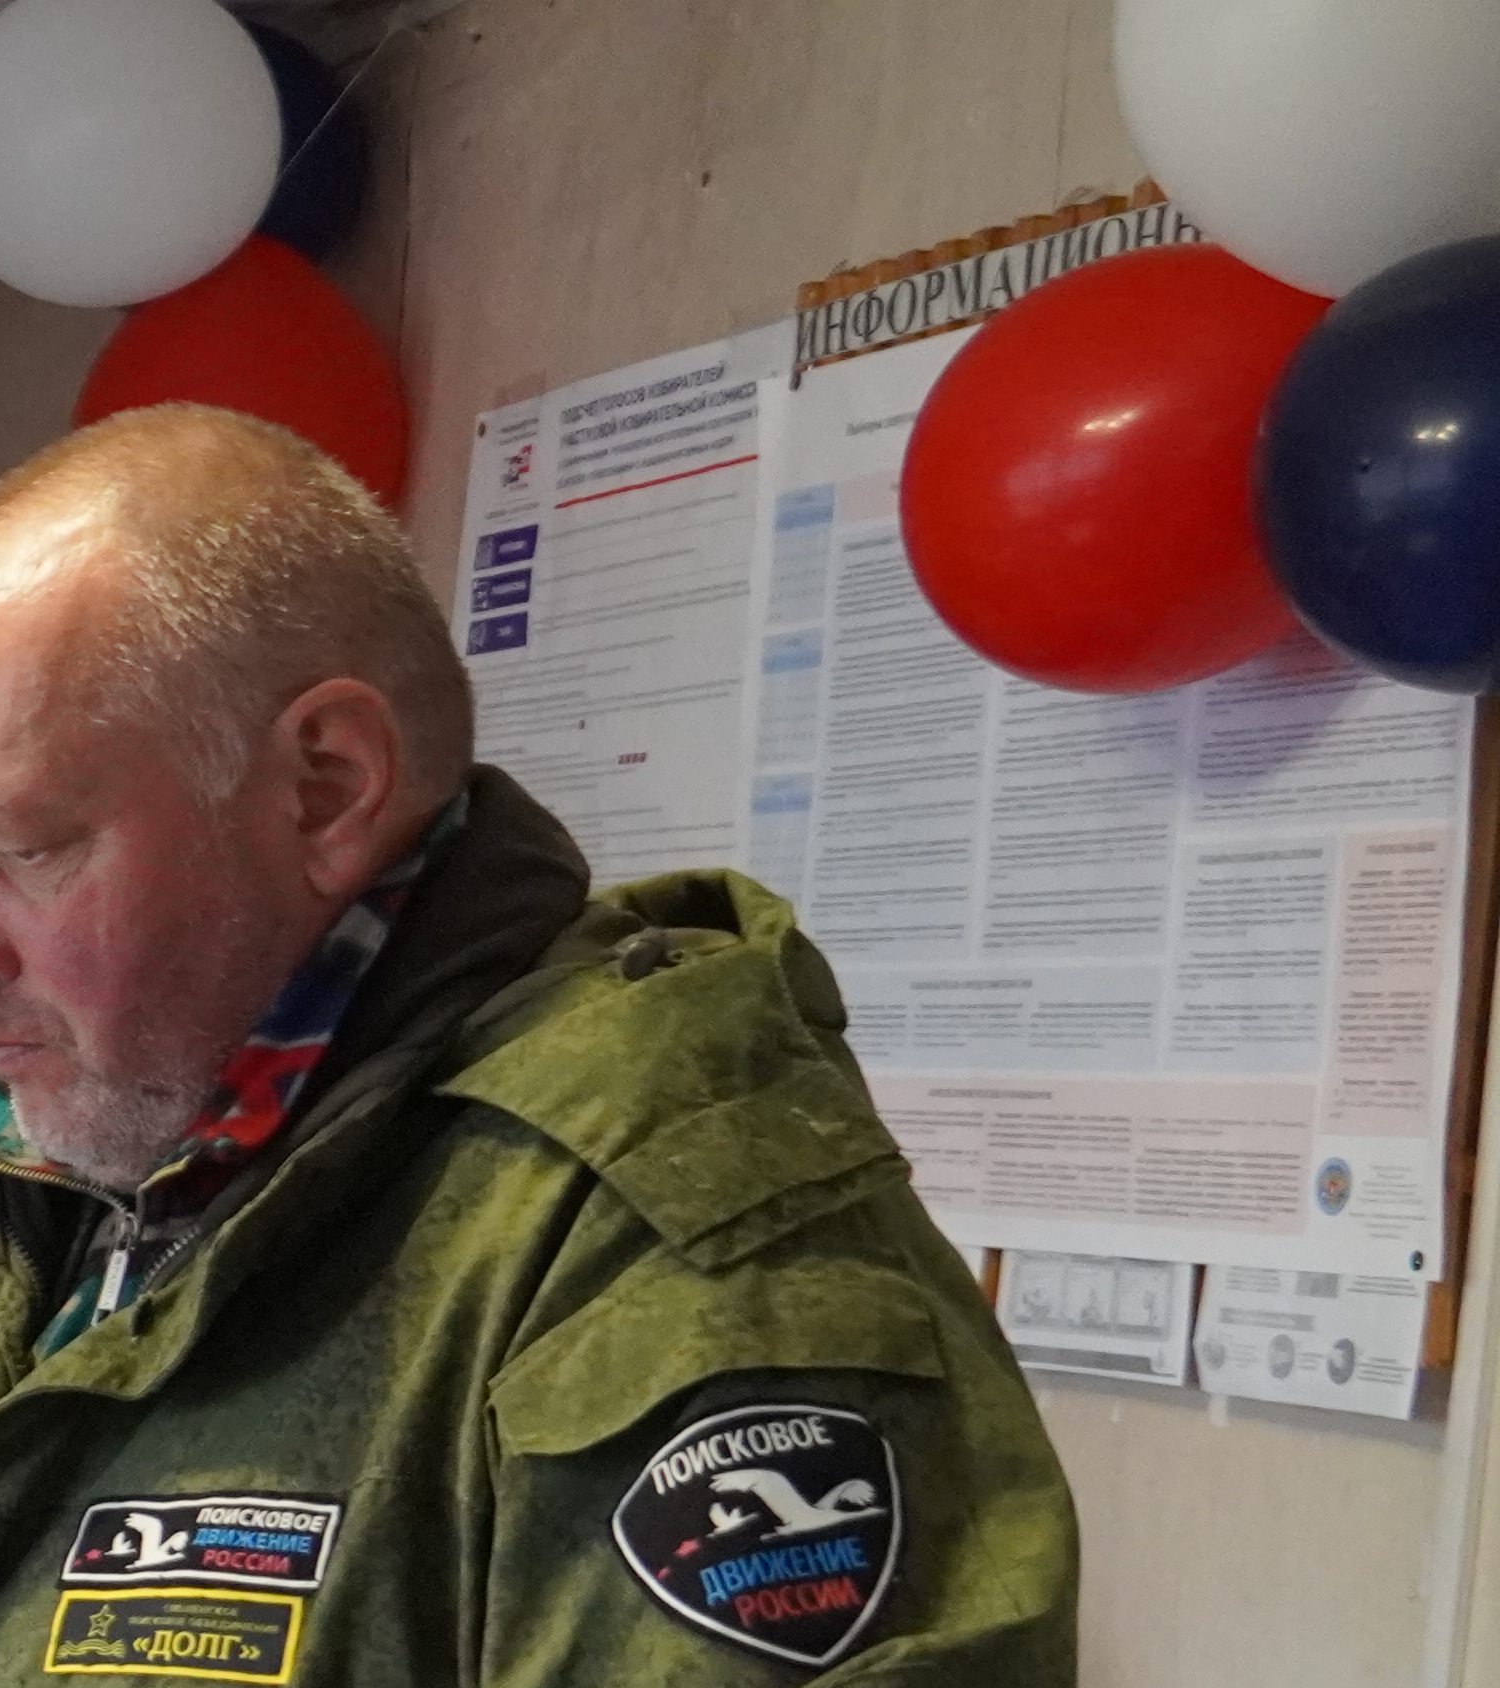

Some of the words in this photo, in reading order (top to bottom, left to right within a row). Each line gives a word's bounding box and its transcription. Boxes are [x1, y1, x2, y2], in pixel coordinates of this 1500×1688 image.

[650, 1415, 835, 1496] ПОИСКОВОЕ
[196, 1507, 329, 1533] ПОИСКОВОЕ
[192, 1527, 314, 1554] ДВИЖЕНИЕ
[202, 1549, 292, 1574] РОССИИ
[700, 1537, 869, 1606] ДВИЖЕНИЕ
[734, 1576, 863, 1628] РОССИИ
[132, 1629, 262, 1661] «ДОЛГ»
